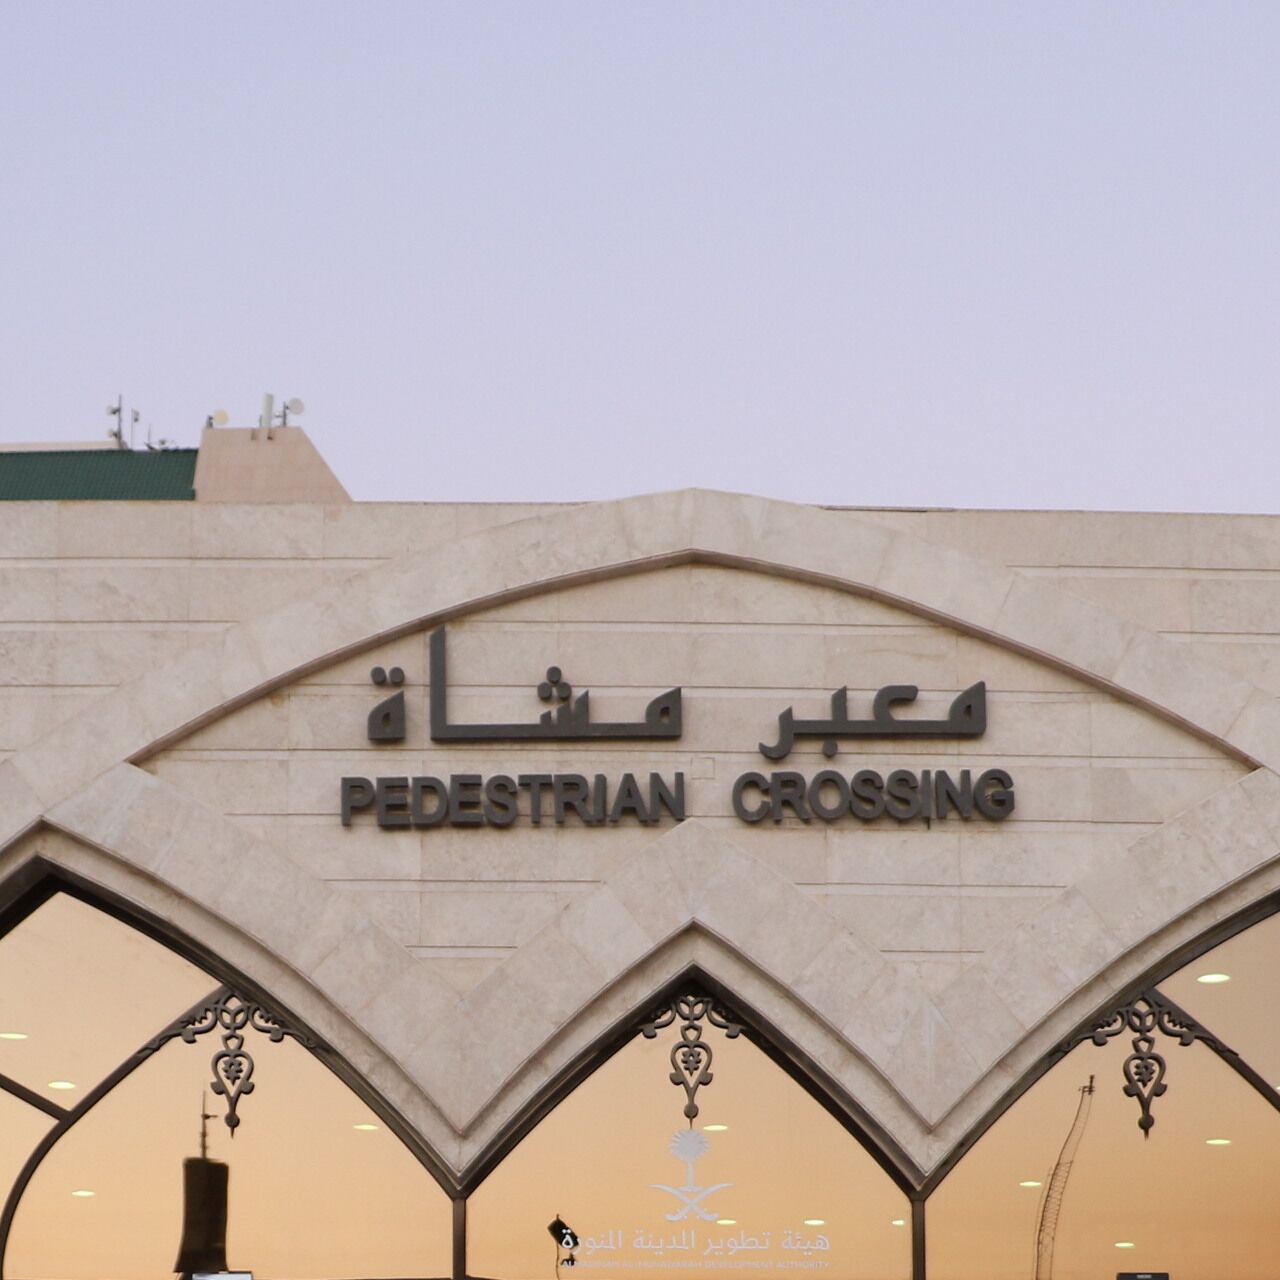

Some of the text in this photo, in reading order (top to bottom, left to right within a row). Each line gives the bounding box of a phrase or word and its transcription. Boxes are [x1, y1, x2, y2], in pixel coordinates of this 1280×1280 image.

[366, 624, 988, 761] معبر مشاة
[340, 768, 1016, 828] PEDESTRIAN CROSSING
[561, 1228, 831, 1256] هيئة تطوير المدينة المنورة
